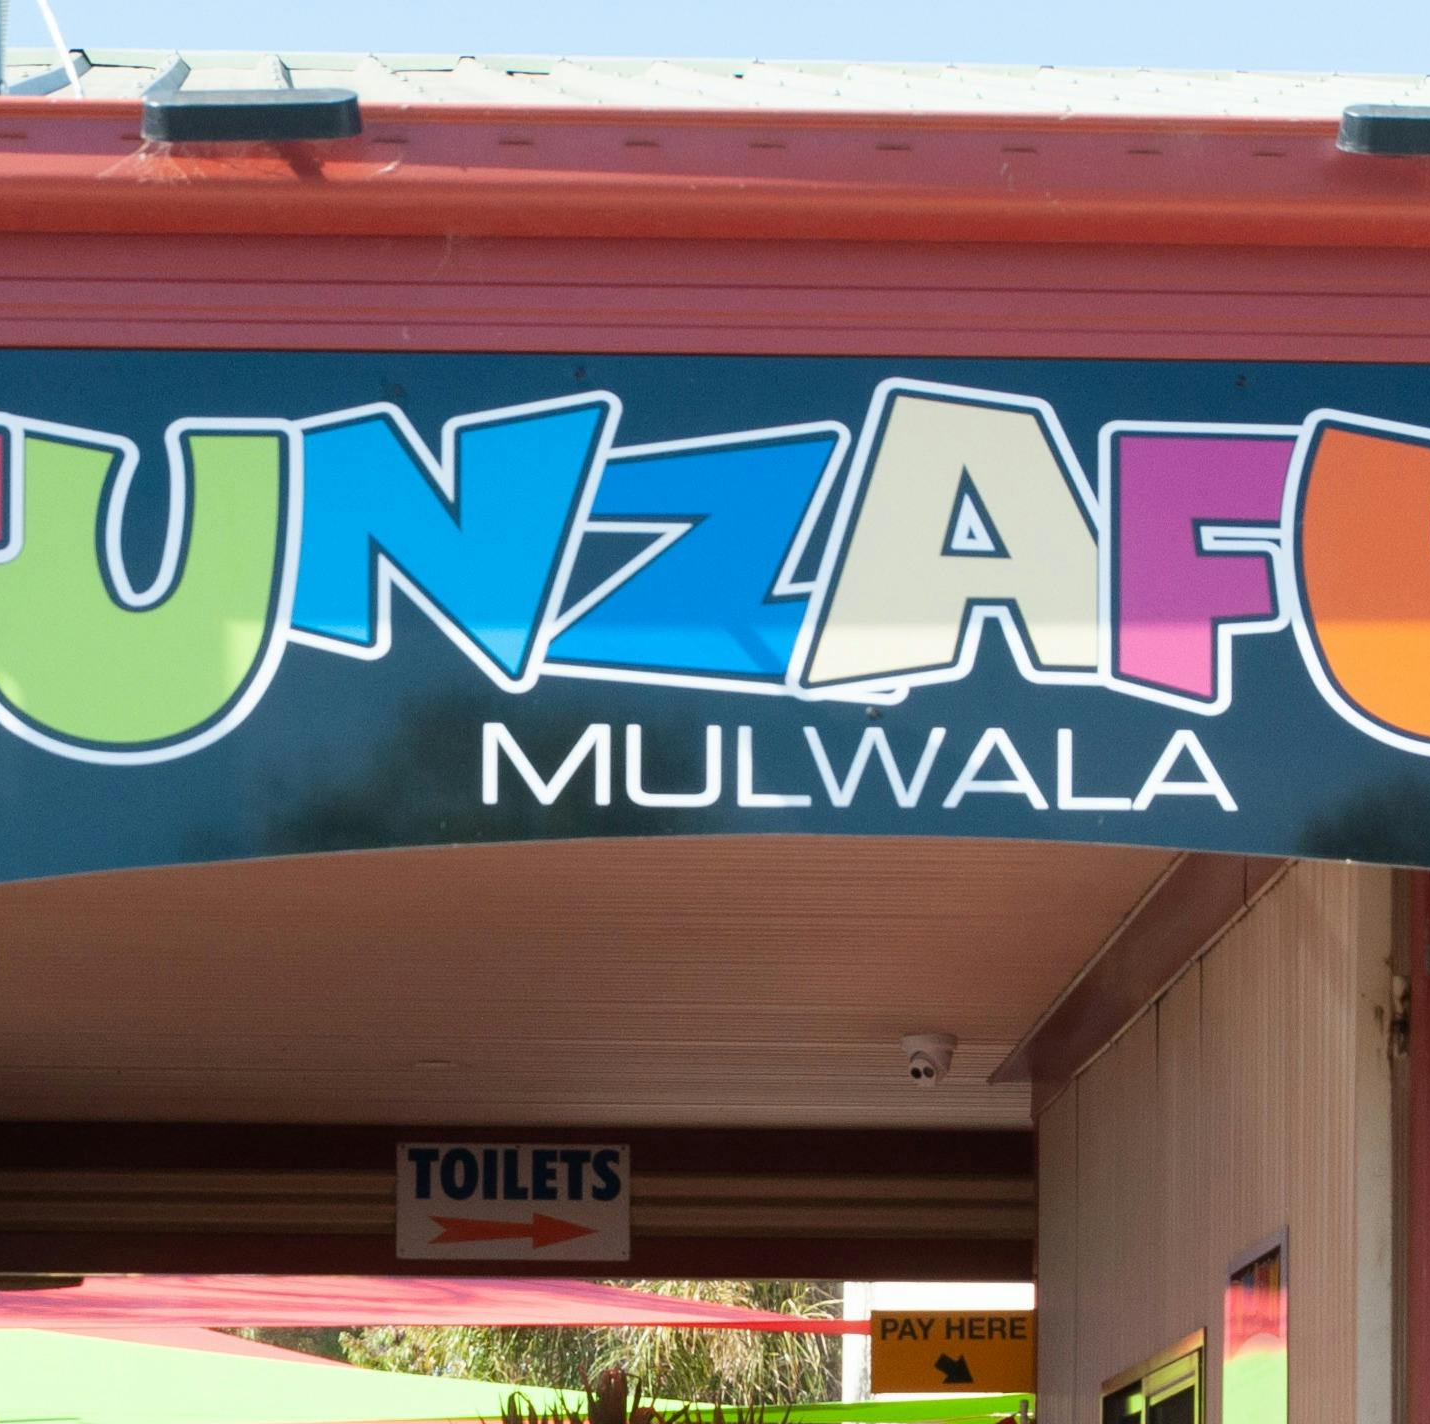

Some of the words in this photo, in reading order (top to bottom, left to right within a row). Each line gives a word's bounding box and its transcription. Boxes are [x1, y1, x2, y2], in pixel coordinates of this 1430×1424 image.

[482, 721, 1239, 813] MULWALA
[408, 1148, 621, 1201] TOILETS
[880, 1316, 935, 1341] PAY
[945, 1316, 1028, 1341] HERE
